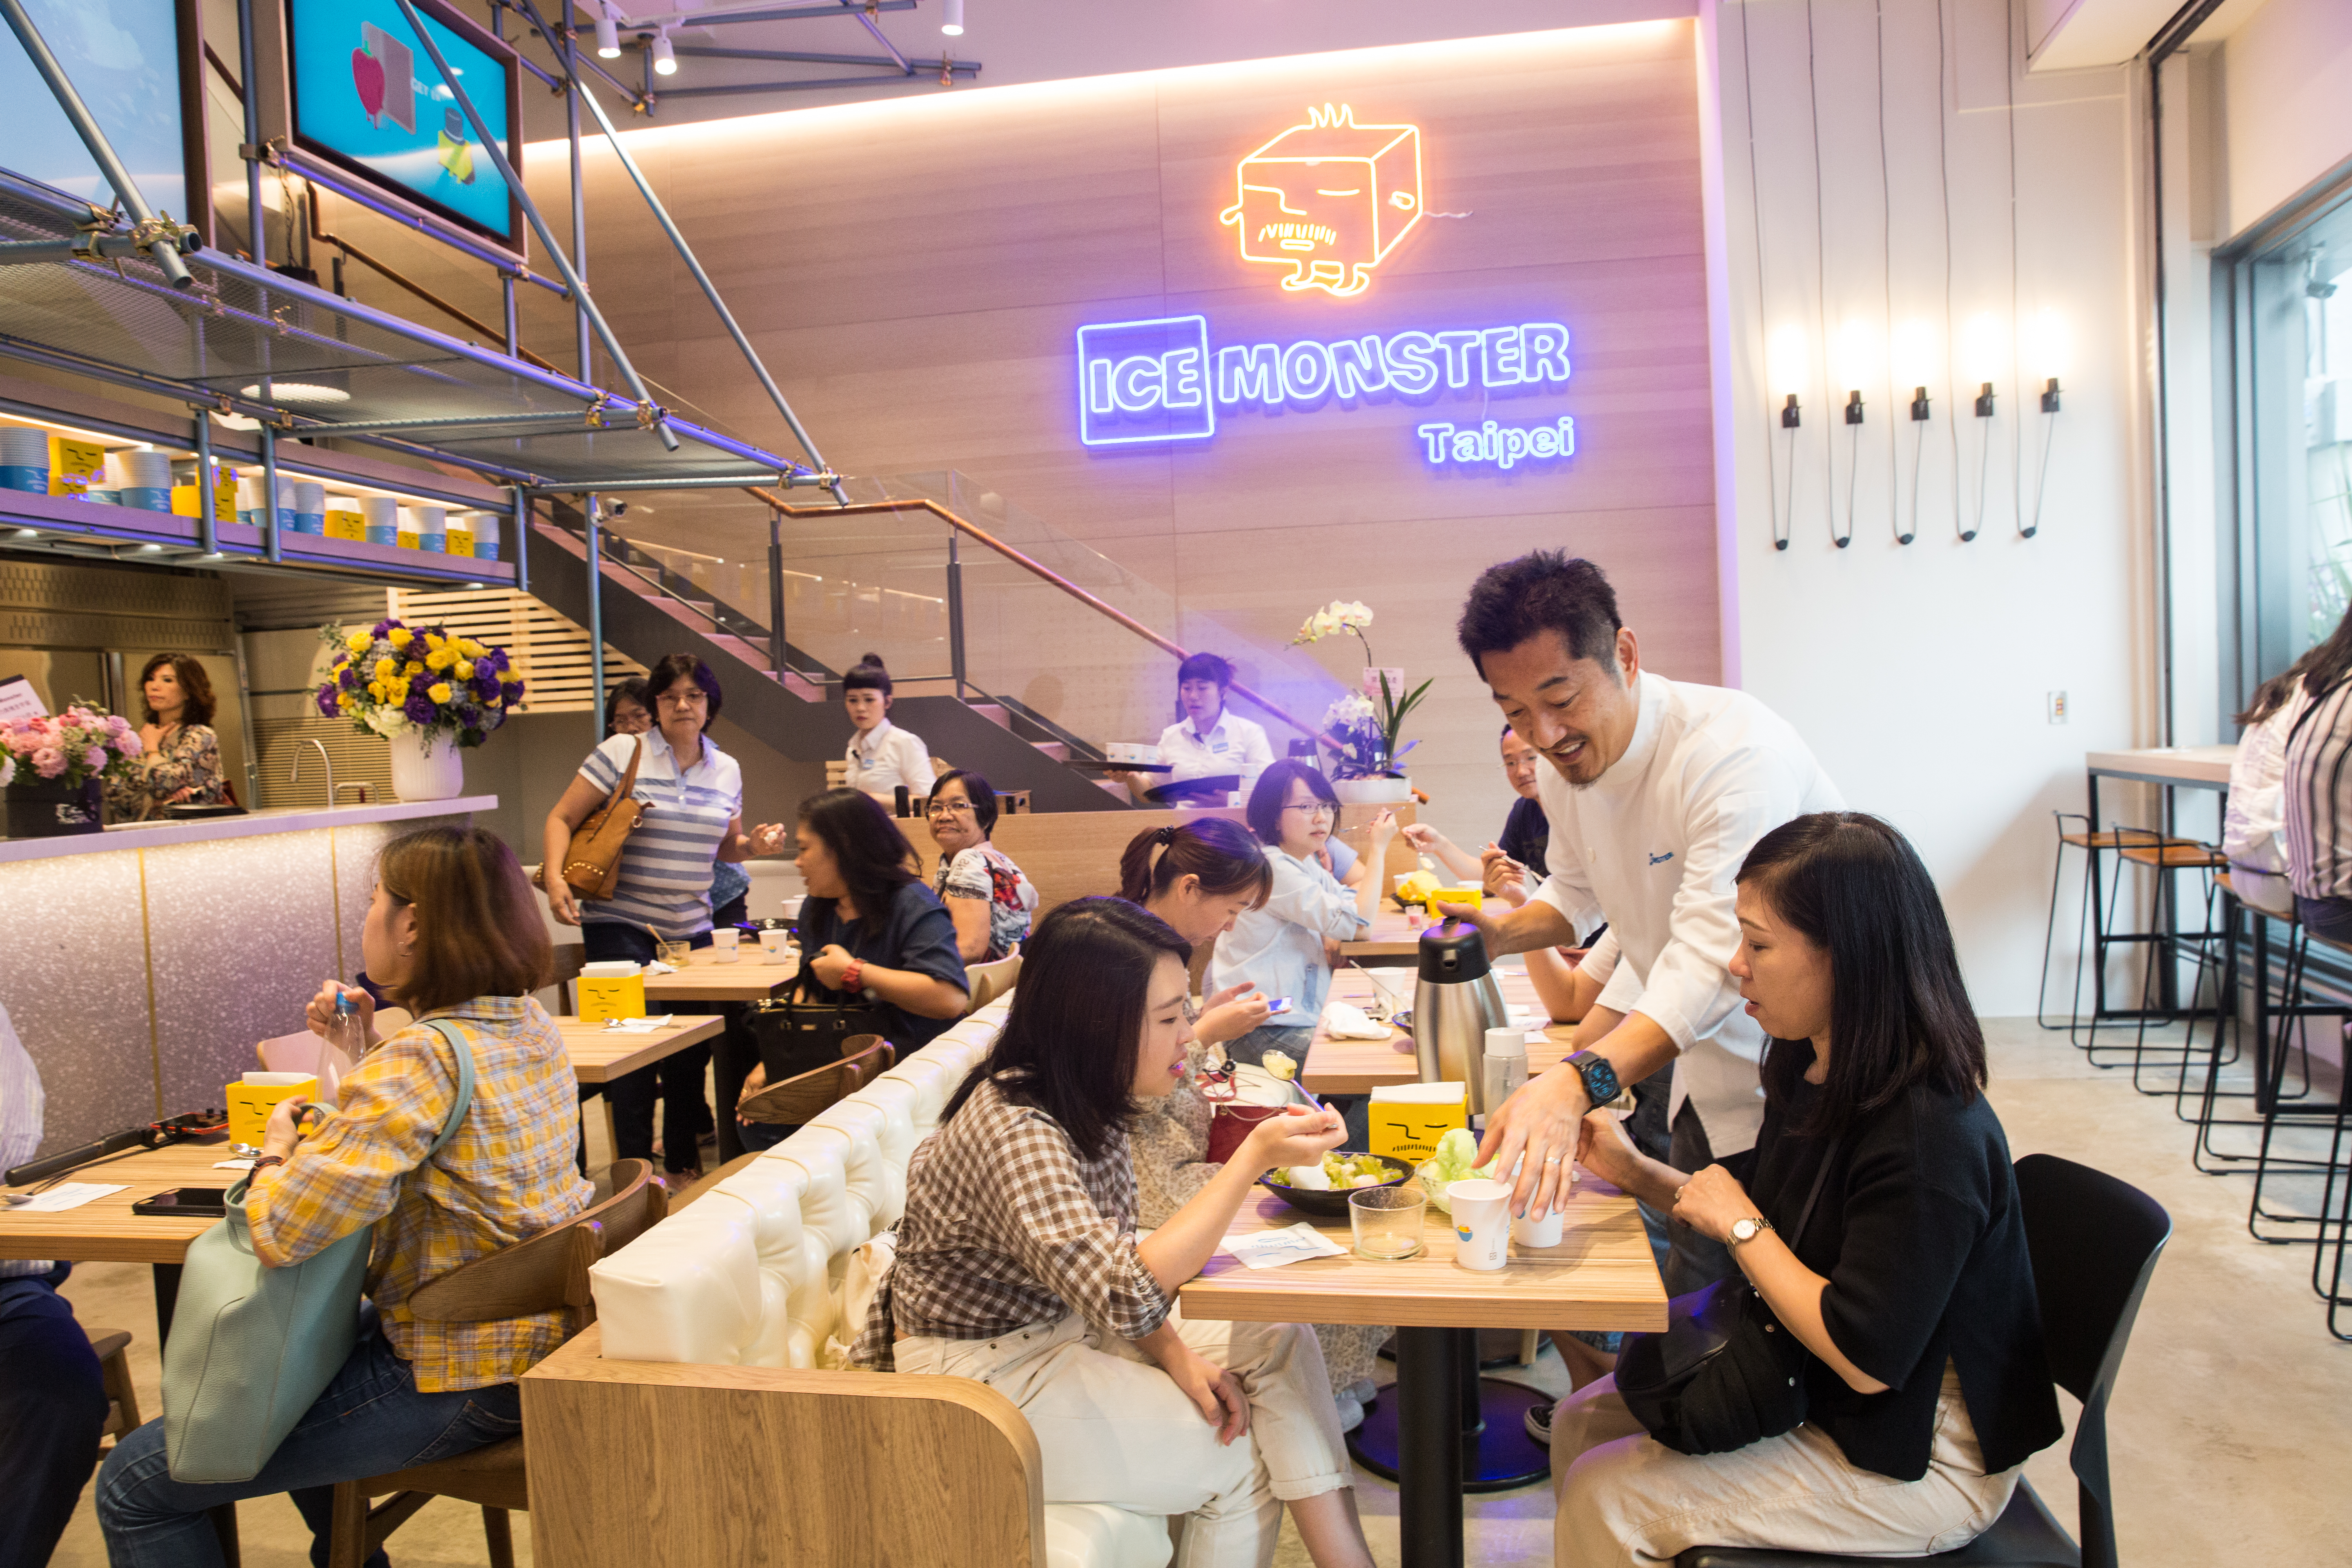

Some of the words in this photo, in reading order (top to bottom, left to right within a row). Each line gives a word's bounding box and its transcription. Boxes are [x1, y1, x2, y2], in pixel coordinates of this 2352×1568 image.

[1089, 347, 1202, 413] ICE
[1218, 323, 1570, 403] MONSTER
[1418, 416, 1574, 469] Taipei
